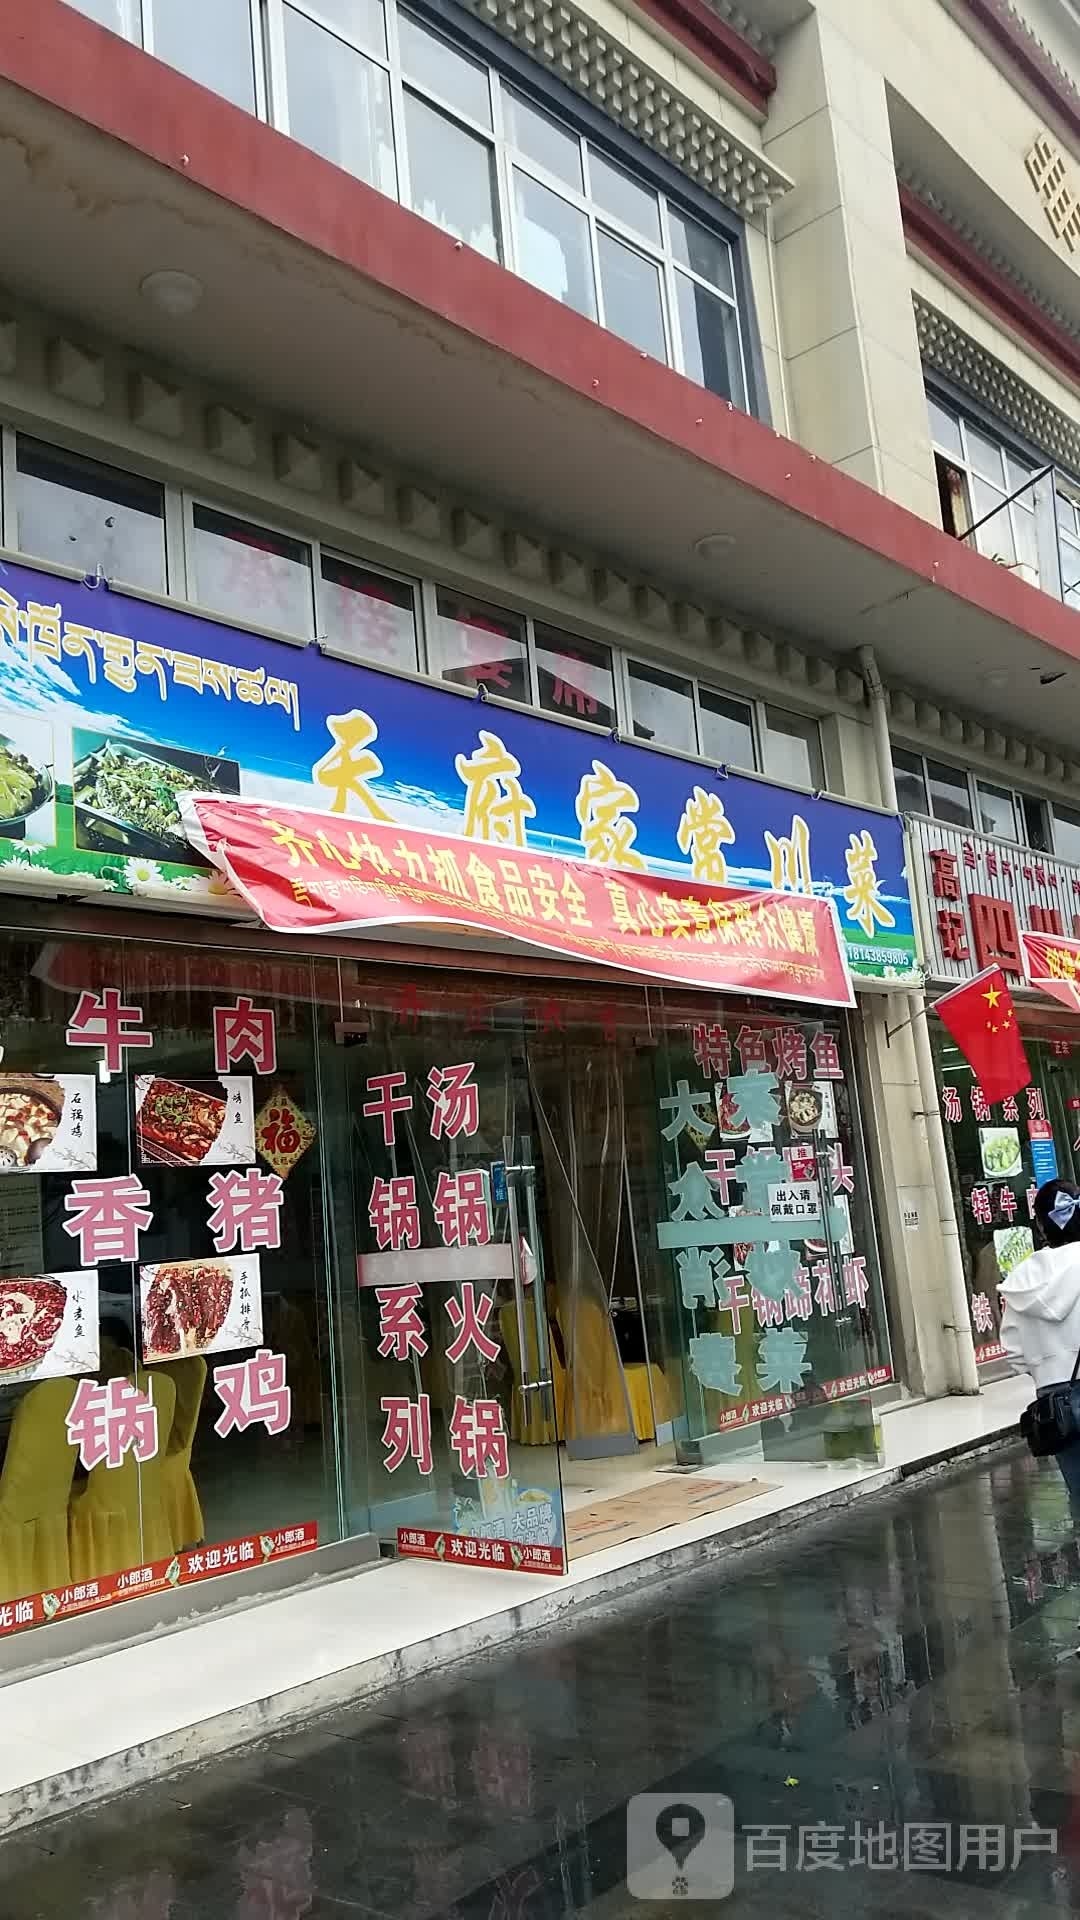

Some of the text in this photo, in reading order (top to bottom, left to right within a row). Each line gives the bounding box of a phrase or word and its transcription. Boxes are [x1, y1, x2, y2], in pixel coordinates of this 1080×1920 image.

[311, 708, 897, 939] 天府家常川菜
[929, 848, 970, 961] 高记
[847, 945, 910, 966] 18143859805
[692, 1023, 844, 1081] 特色烤鱼
[770, 1203, 819, 1217] 佩戴口罩
[775, 1188, 811, 1202] 出入请
[751, 1399, 784, 1418] 欢迎光临
[400, 1532, 427, 1547] 小郎酒
[450, 1539, 506, 1563] 欢迎光临
[522, 1546, 552, 1563] 小郎酒
[60, 1581, 99, 1604] 小郎酒
[116, 1567, 154, 1589] 小郎酒
[187, 1540, 255, 1575] 欢迎光临
[273, 1527, 306, 1546] 小郎酒
